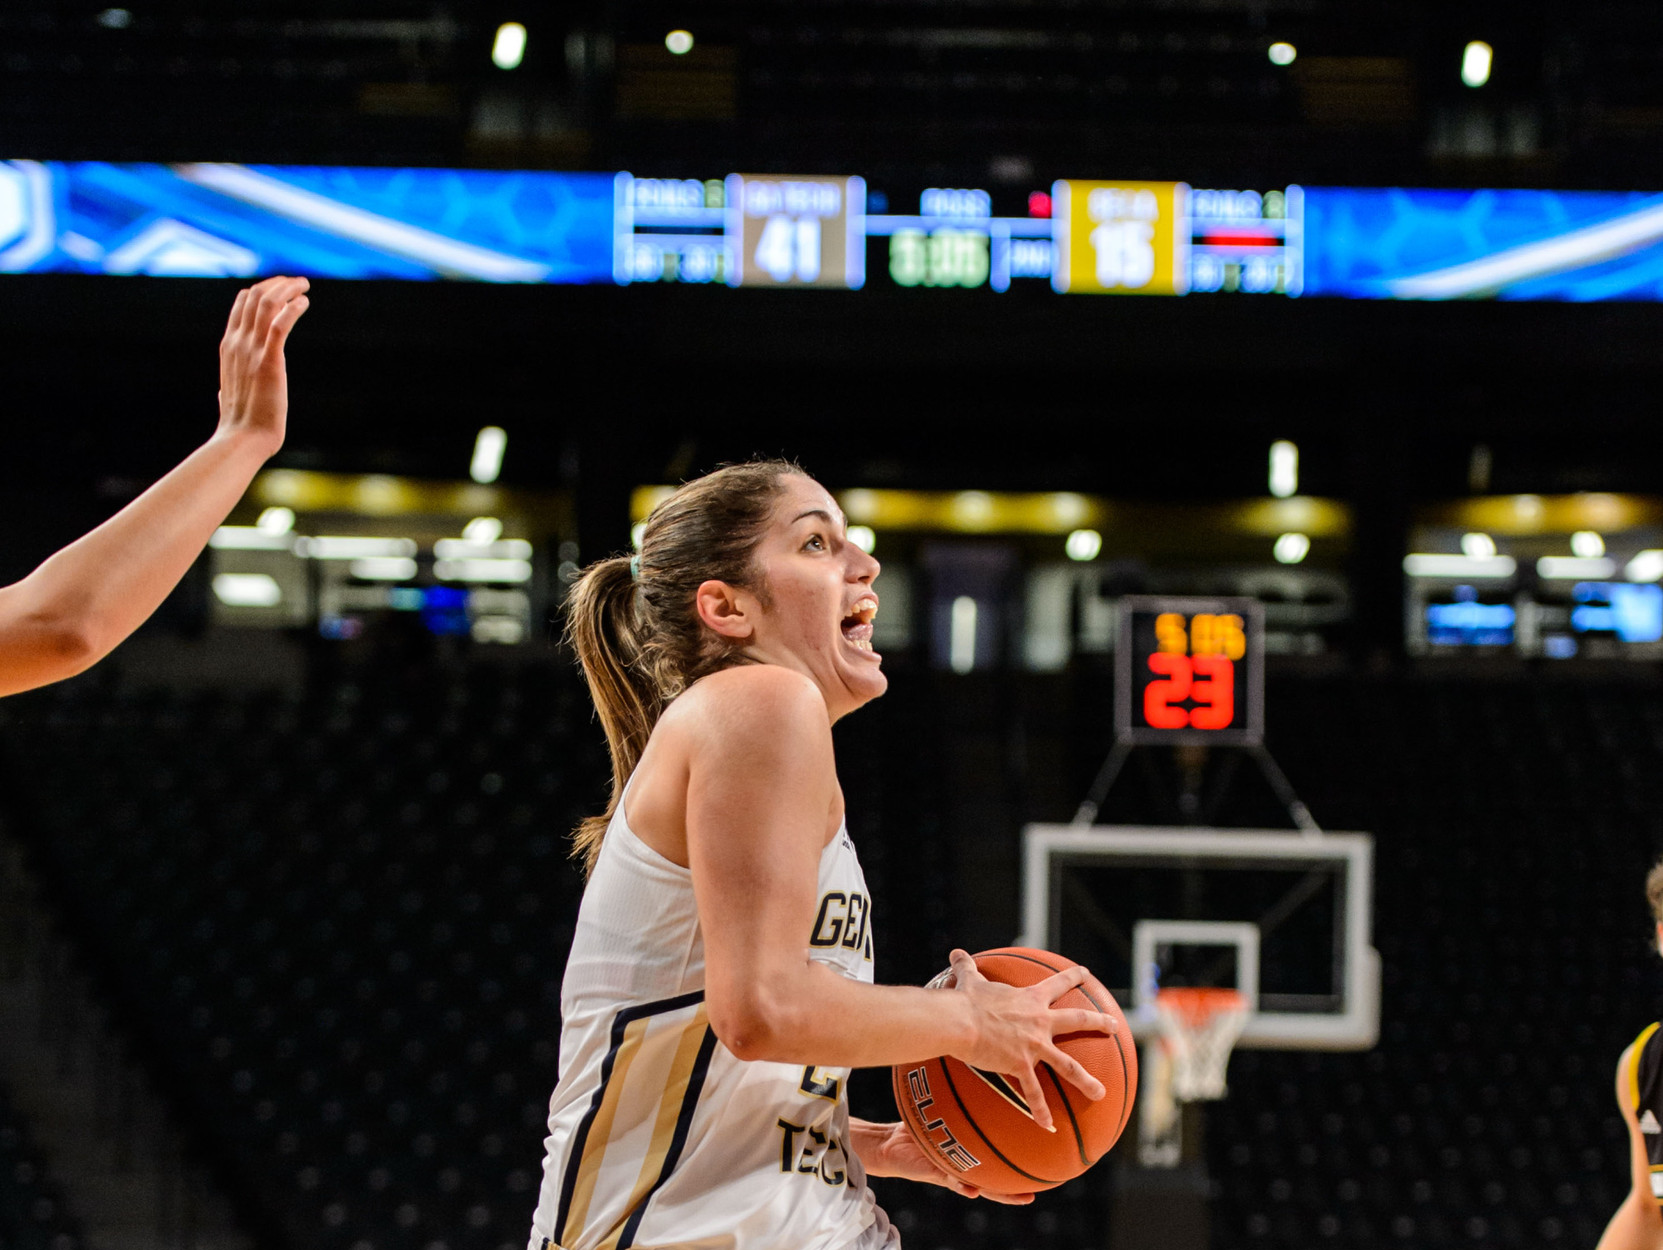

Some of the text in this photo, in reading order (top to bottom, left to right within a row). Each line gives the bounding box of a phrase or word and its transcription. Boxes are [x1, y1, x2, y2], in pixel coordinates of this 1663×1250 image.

[754, 212, 821, 283] 41
[1143, 651, 1235, 730] 23
[908, 1065, 982, 1172] ELITE
